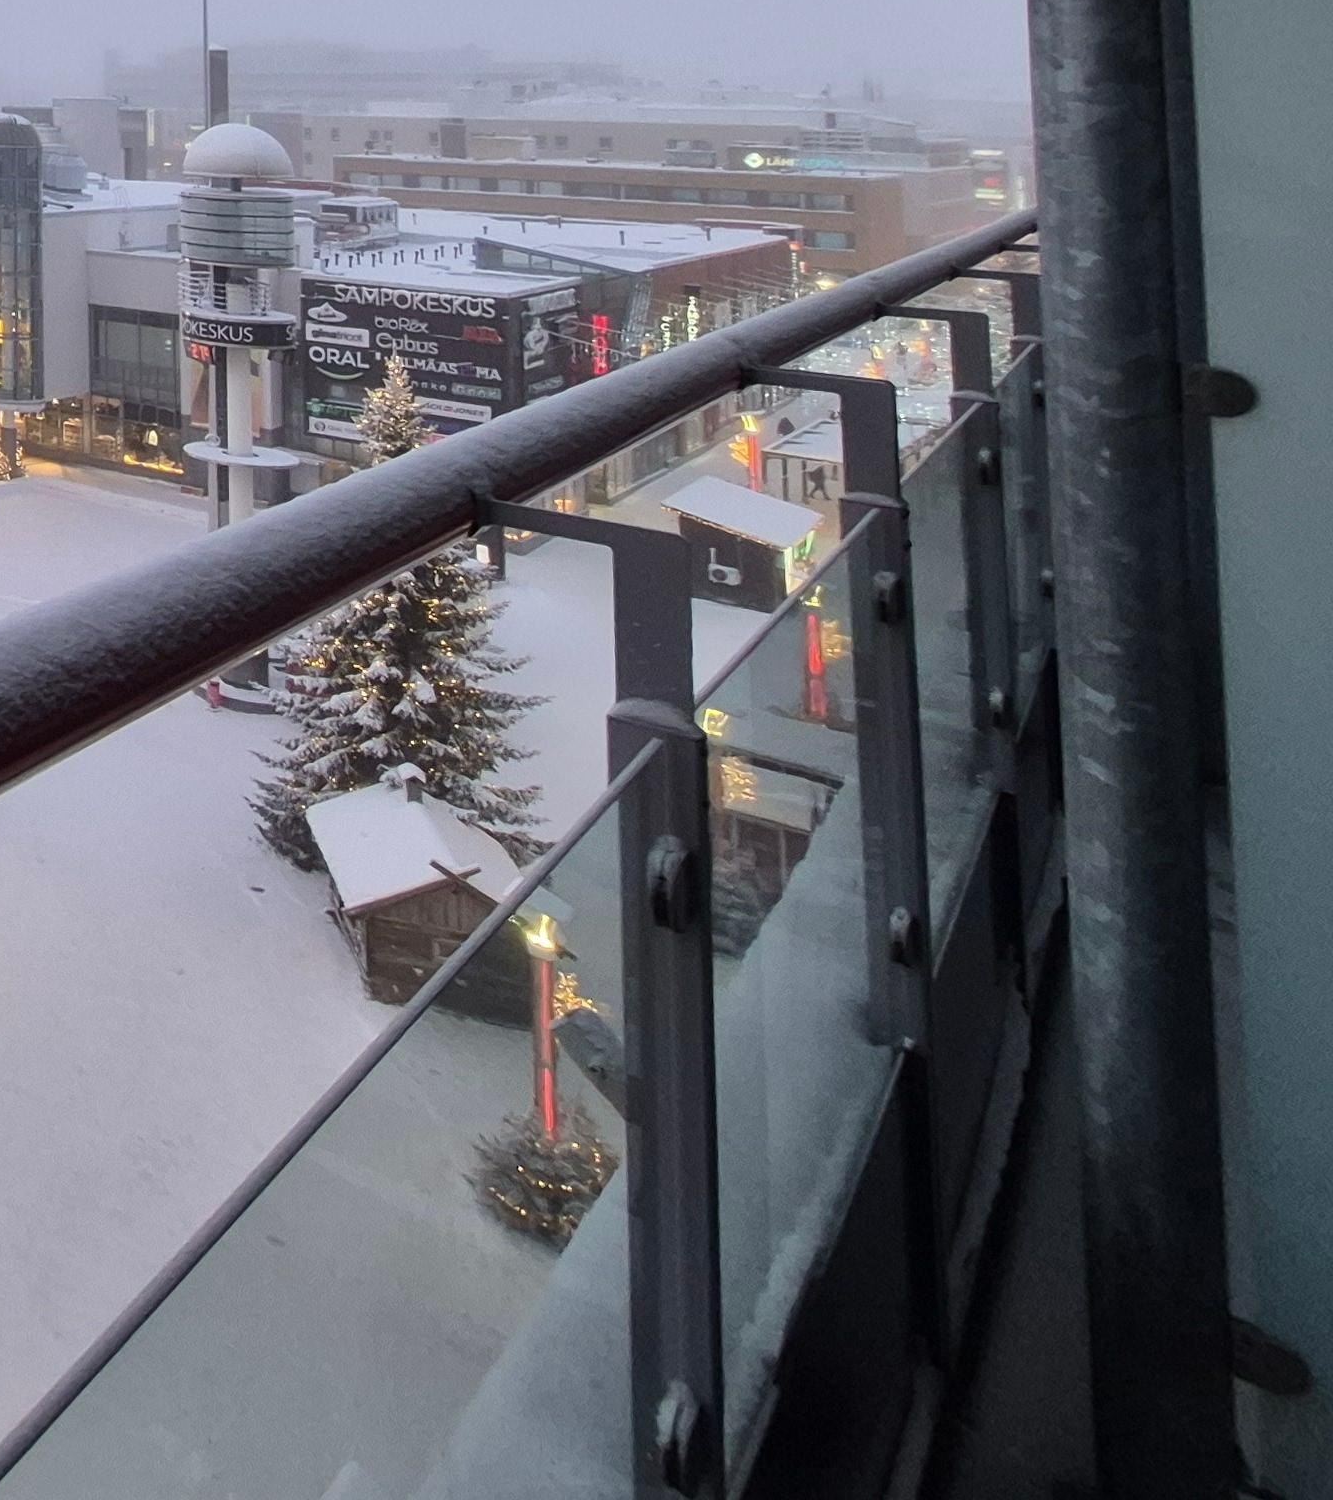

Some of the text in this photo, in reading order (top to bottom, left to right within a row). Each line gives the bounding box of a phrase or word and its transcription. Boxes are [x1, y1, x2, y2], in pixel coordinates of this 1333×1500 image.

[334, 284, 495, 319] SAMPOKESKUS
[308, 345, 370, 370] ORAL
[399, 356, 503, 382] ILMÄASMA
